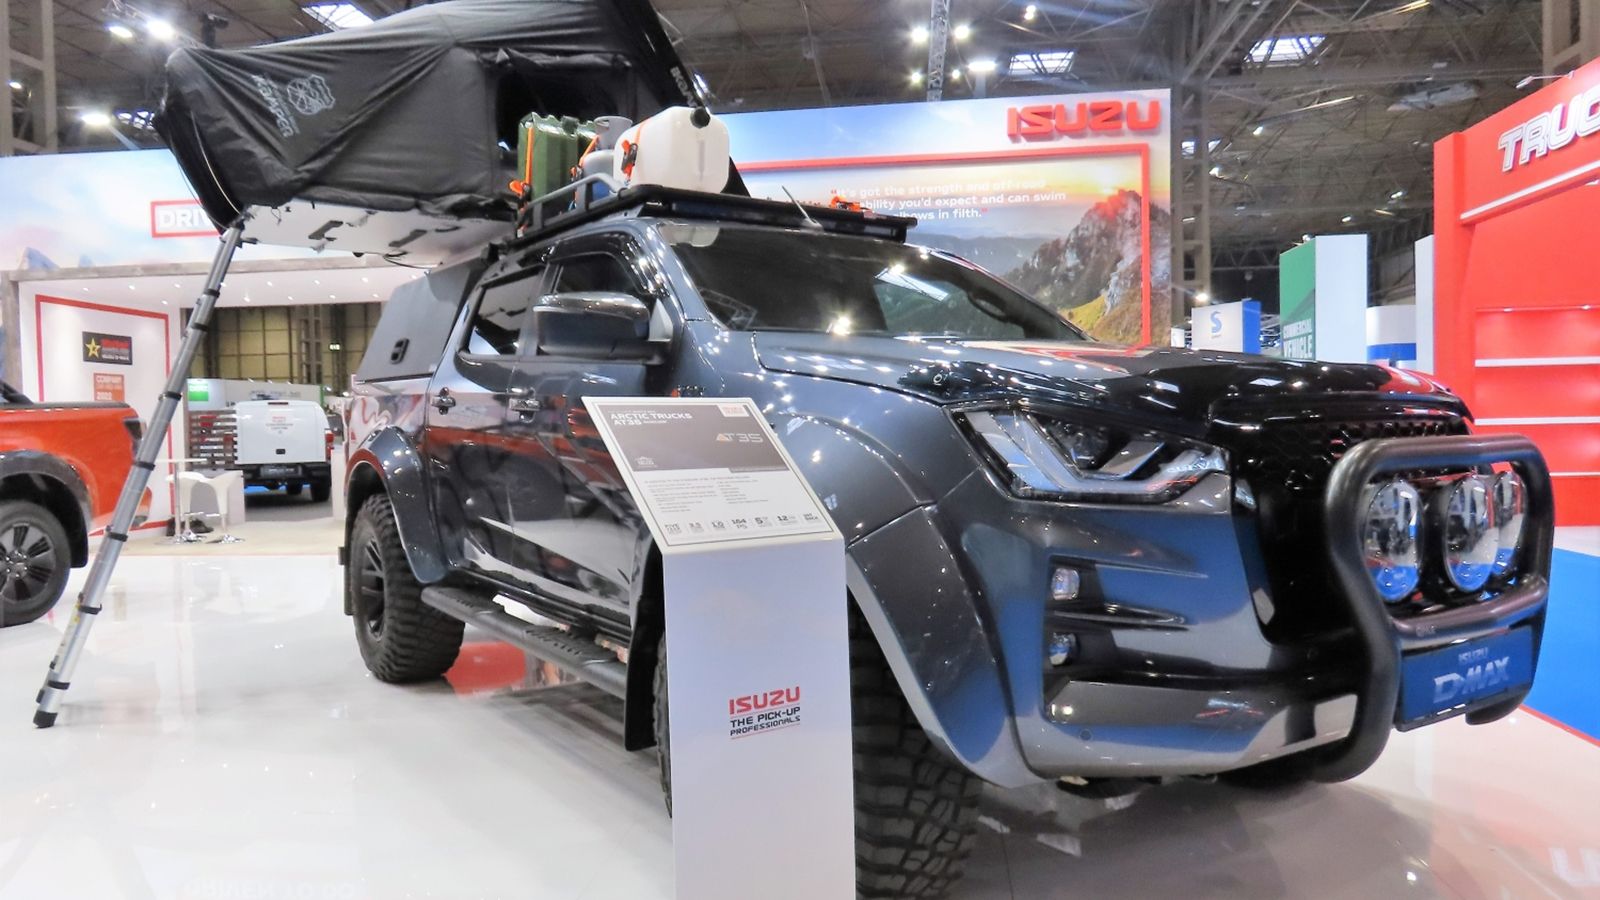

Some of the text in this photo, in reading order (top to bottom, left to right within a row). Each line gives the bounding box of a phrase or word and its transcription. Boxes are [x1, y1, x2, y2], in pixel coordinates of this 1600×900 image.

[1007, 100, 1161, 137] ISUZU
[861, 188, 881, 199] got
[884, 185, 905, 195] the
[908, 182, 962, 196] strength
[967, 182, 990, 192] and
[899, 197, 932, 209] you'd
[935, 195, 978, 208] expect
[981, 193, 1005, 204] and
[1007, 194, 1030, 204] can
[1033, 192, 1067, 202] swim
[938, 209, 950, 220] in
[1283, 334, 1312, 358] VEHICLE
[716, 432, 764, 443] AT35
[729, 686, 800, 715] ISUZU
[730, 706, 801, 728] THE PICK-UP
[730, 715, 801, 736] PROFESSIONALS
